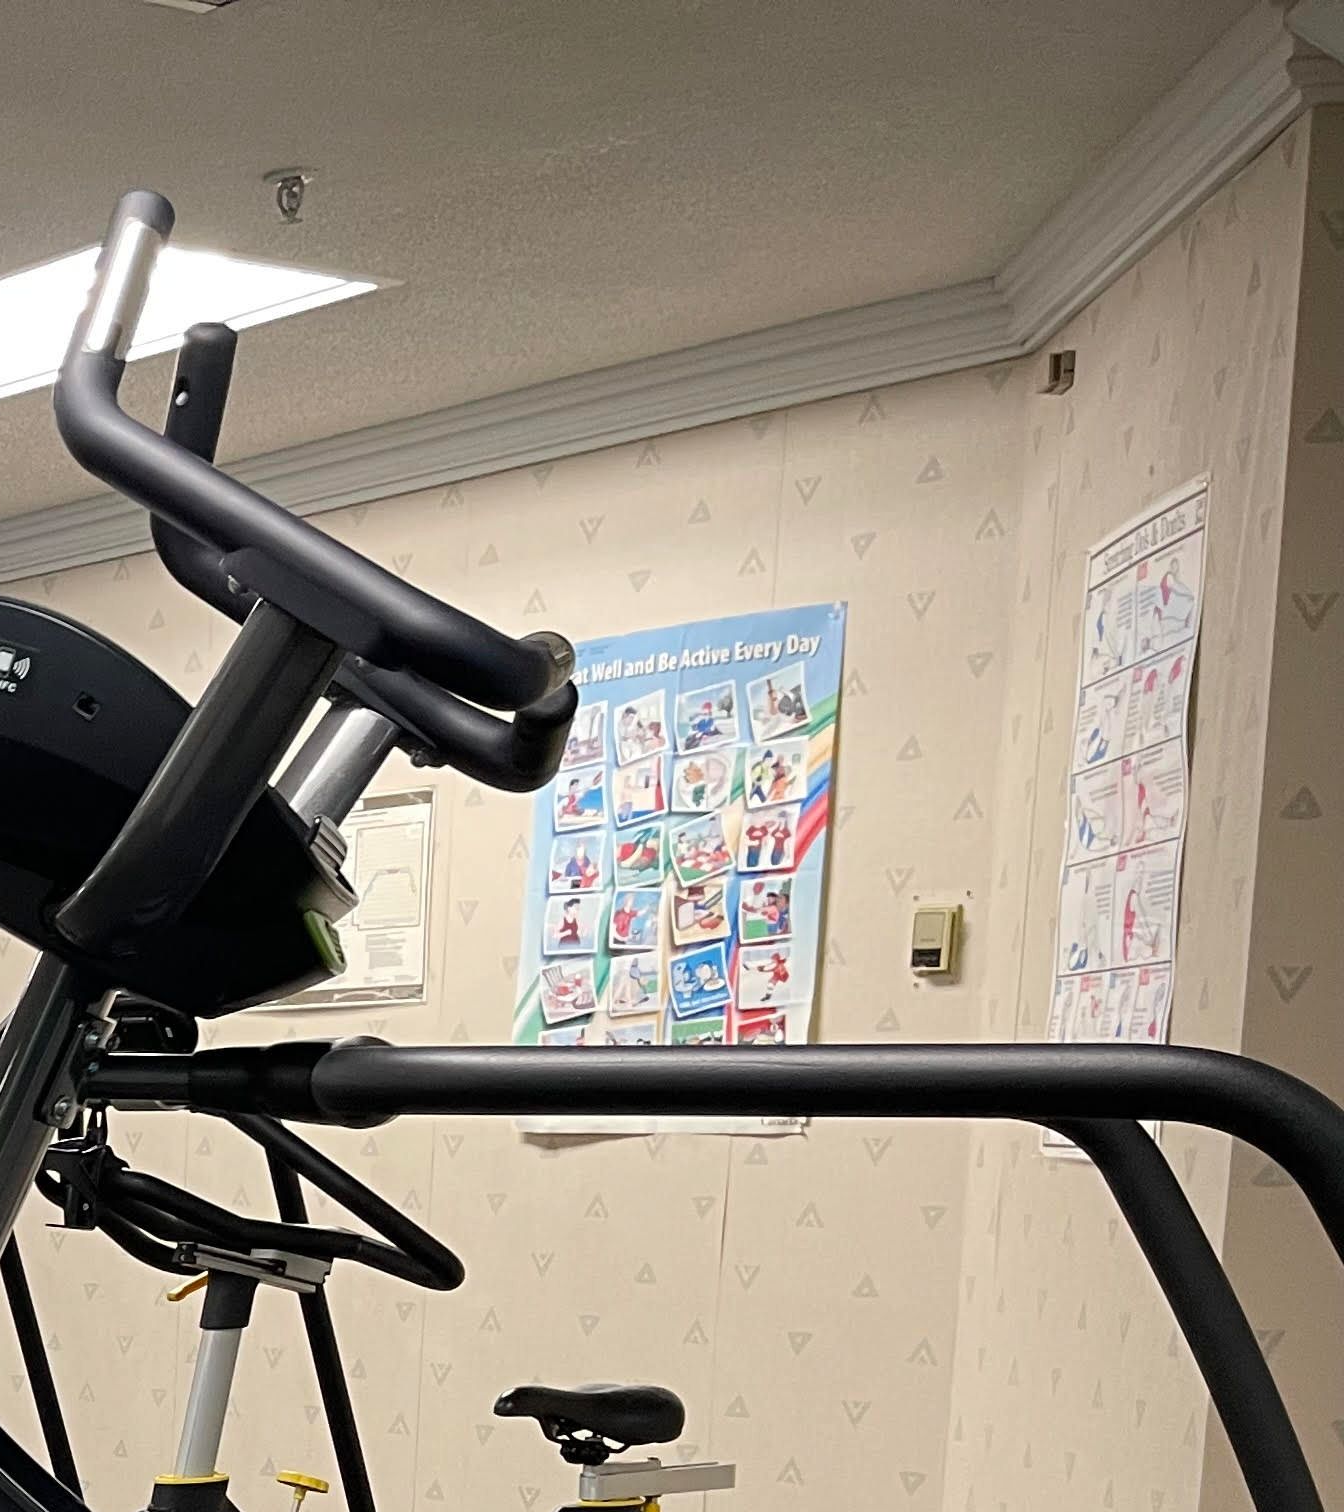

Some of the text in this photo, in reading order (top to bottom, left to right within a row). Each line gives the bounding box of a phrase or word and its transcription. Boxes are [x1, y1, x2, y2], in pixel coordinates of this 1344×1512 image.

[569, 633, 821, 686] at Well and Be Active Every Day
